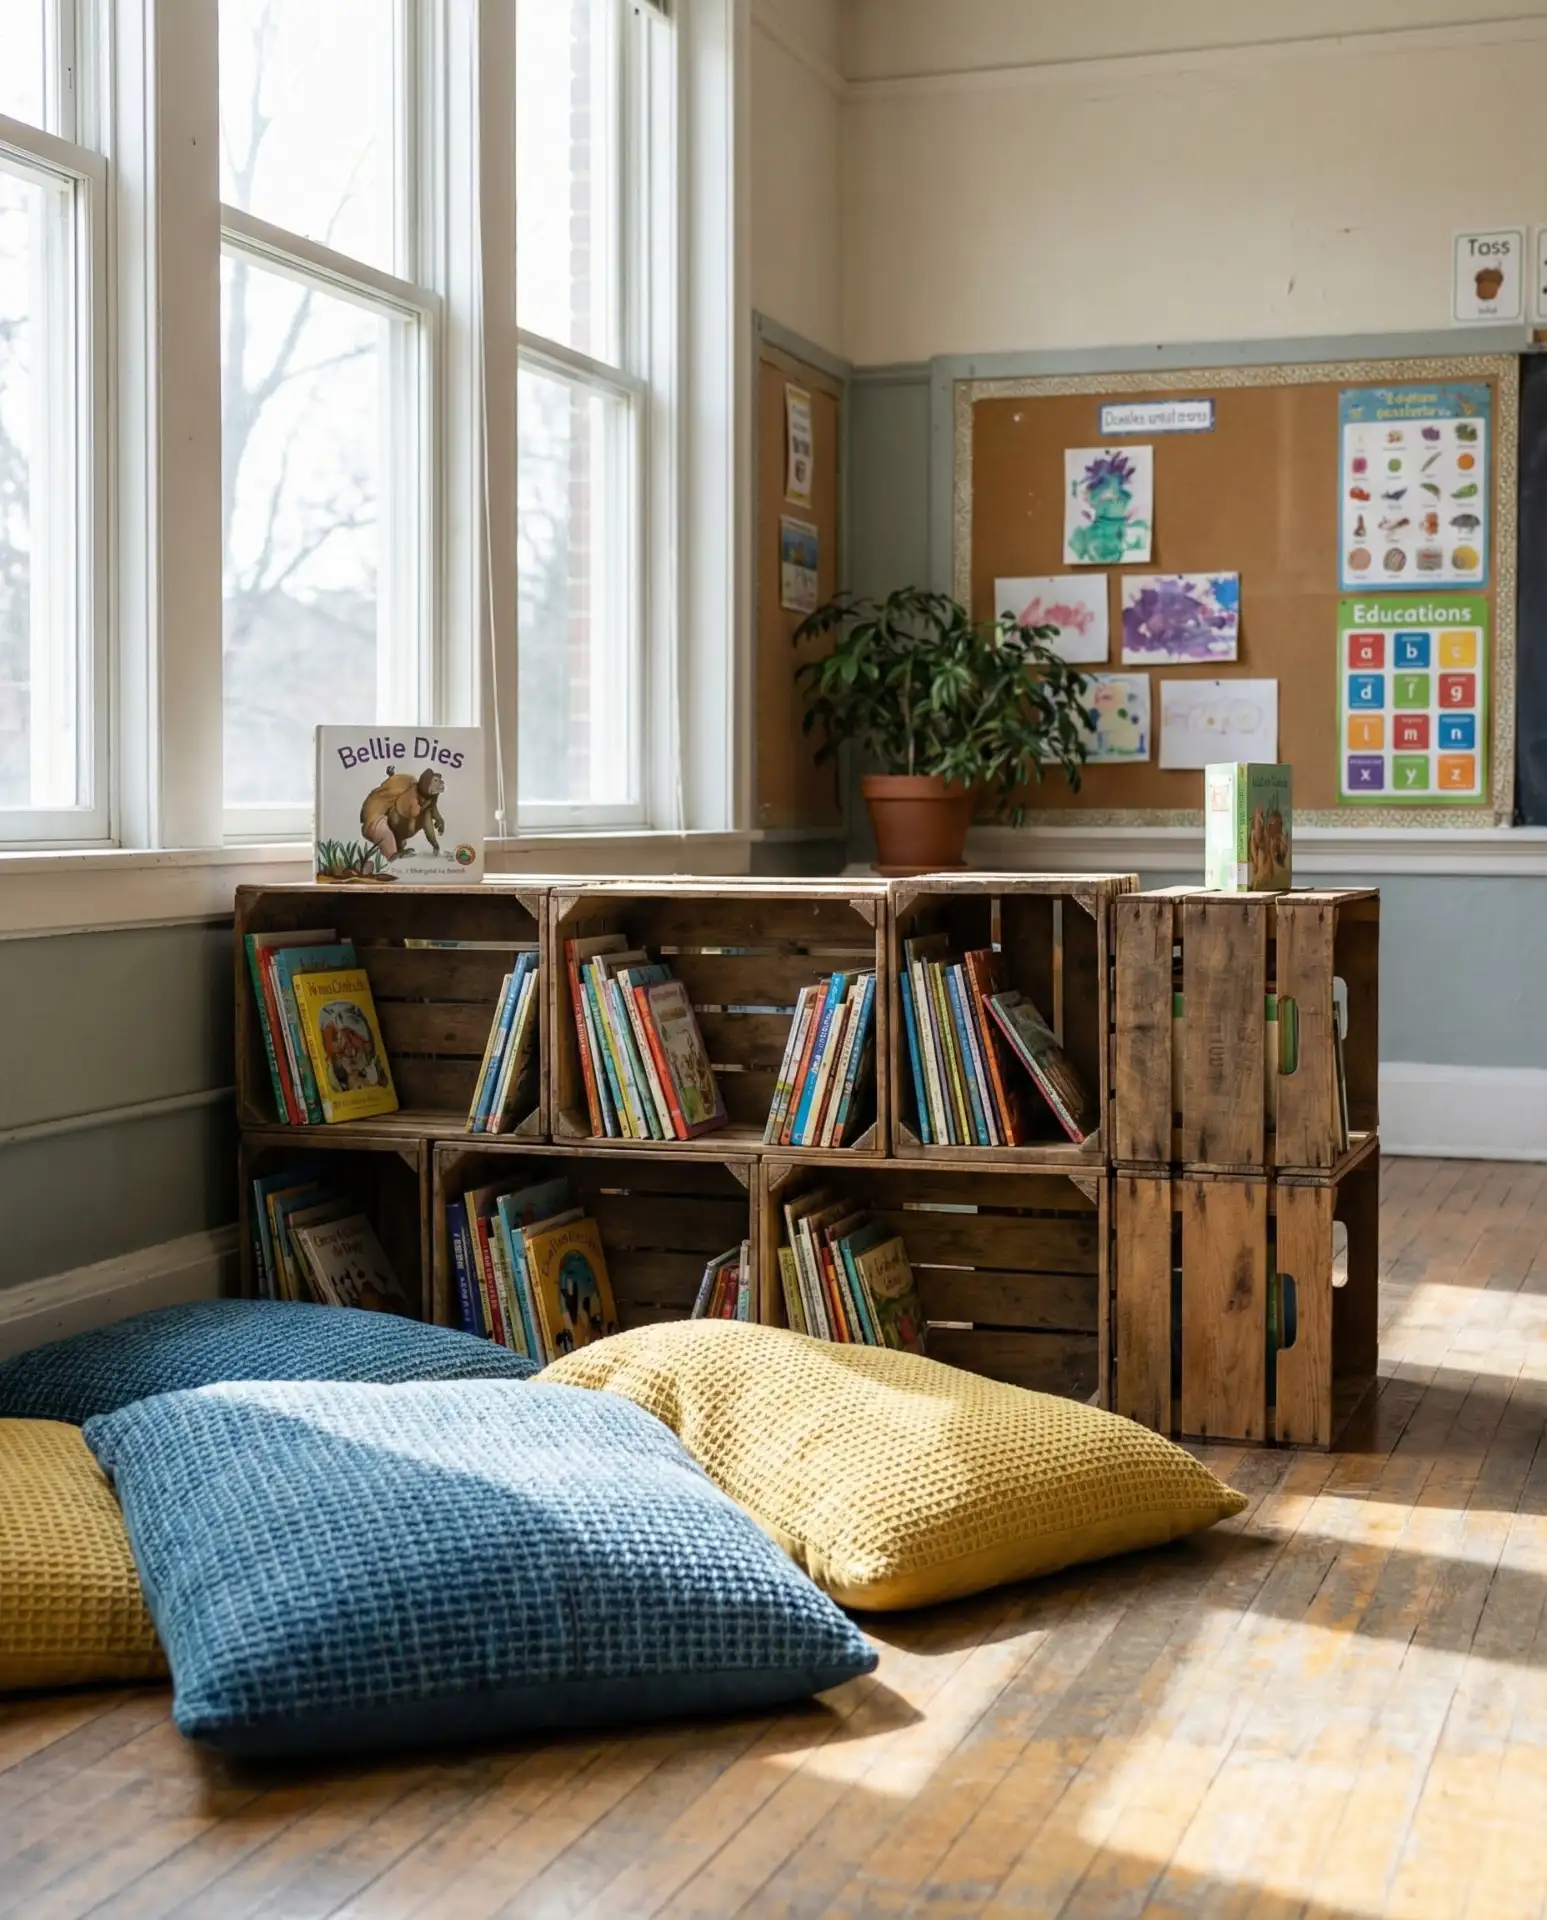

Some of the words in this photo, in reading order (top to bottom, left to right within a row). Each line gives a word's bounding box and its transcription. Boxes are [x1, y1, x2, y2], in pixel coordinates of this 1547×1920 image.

[1353, 604, 1472, 624] Educations
[1361, 647, 1372, 659] a
[1407, 643, 1418, 659] b
[1361, 685, 1372, 700] d
[1451, 685, 1462, 701] g
[1404, 728, 1418, 740] m
[1451, 728, 1462, 740] n
[337, 736, 406, 770] Bellie
[413, 736, 465, 769] Dies
[1360, 768, 1371, 782] x
[1406, 768, 1417, 784] y
[1451, 768, 1461, 781] z
